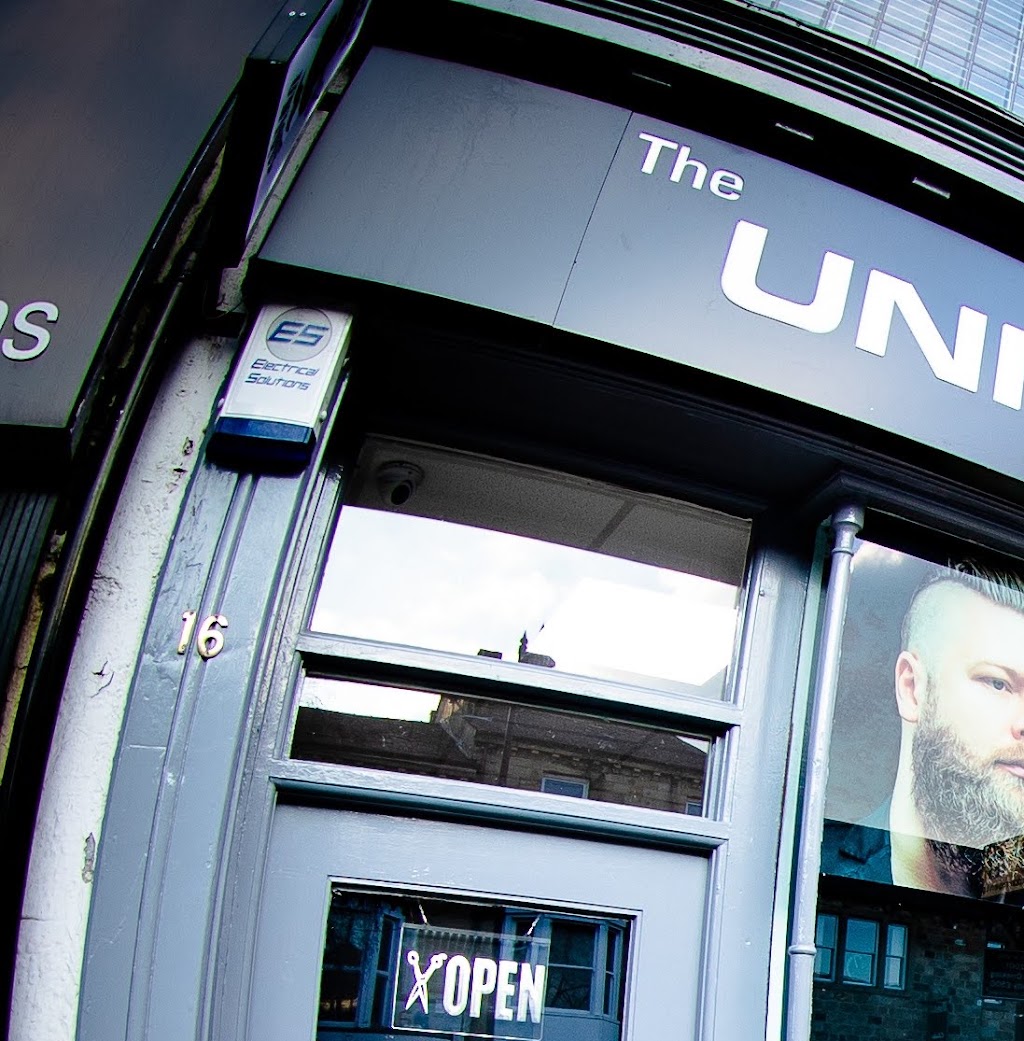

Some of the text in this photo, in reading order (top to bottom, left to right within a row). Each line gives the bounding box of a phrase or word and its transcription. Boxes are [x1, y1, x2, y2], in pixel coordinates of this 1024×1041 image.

[638, 131, 745, 201] The
[266, 321, 330, 346] ES
[245, 372, 311, 391] Solutions
[251, 358, 320, 377] Electrical
[177, 610, 228, 661] 16
[442, 954, 546, 1024] OPEN
